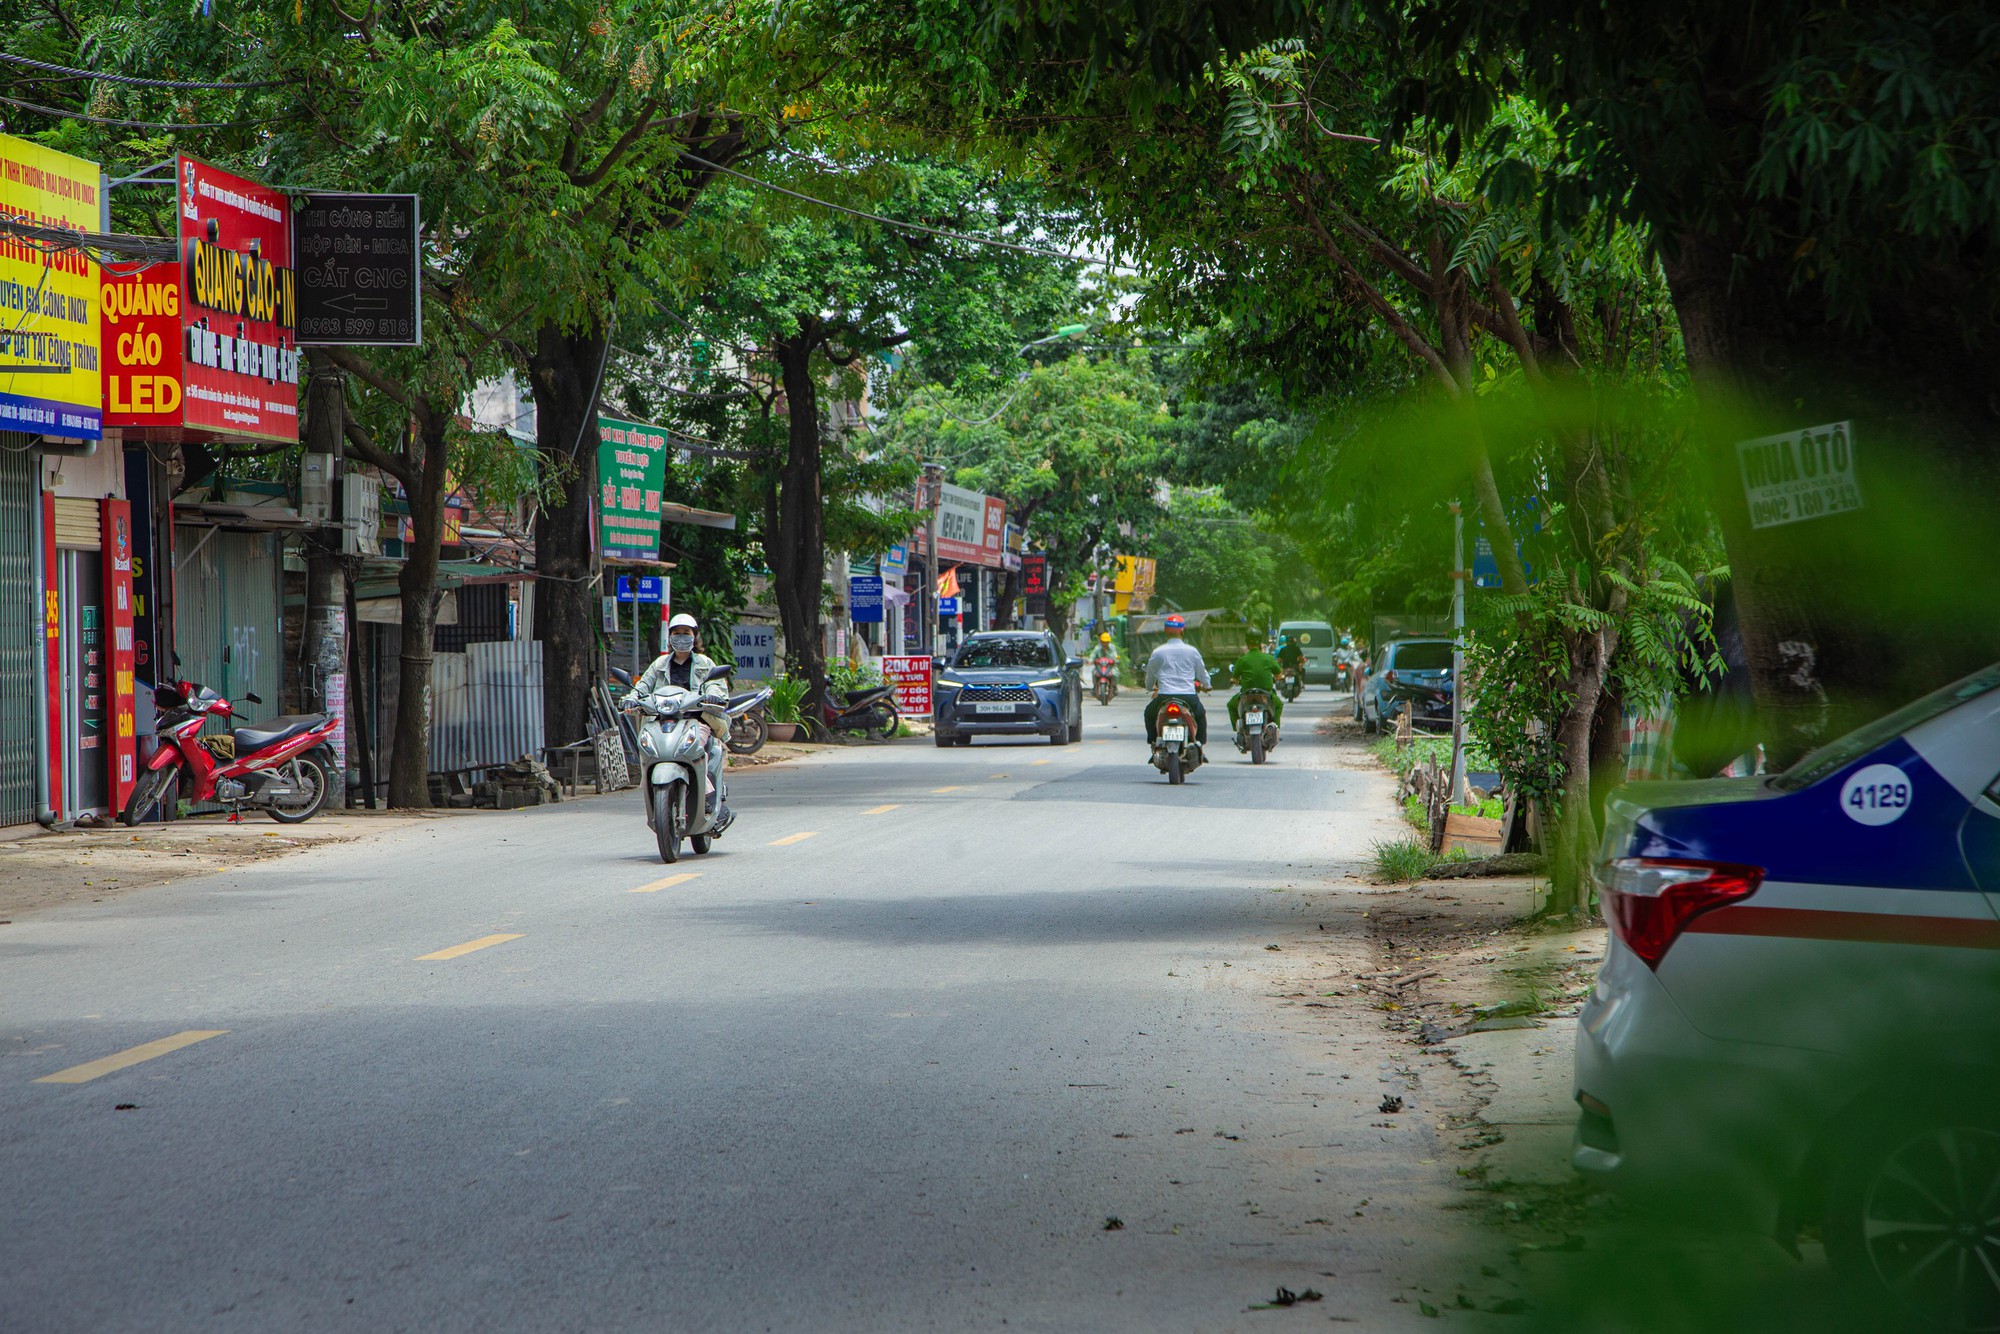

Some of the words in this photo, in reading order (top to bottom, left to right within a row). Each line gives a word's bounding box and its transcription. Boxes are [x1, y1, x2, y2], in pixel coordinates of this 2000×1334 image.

[82, 184, 95, 206] INOX
[304, 210, 325, 227] THI
[329, 206, 372, 227] CÔNG
[376, 203, 405, 228] BIỂN
[302, 233, 331, 257] HỘP
[334, 233, 361, 253] ĐÈN
[373, 238, 409, 254] MICA
[188, 217, 243, 316] QUẢNG
[303, 257, 349, 288] CẮT
[355, 267, 407, 288] CNC
[68, 296, 88, 325] INOX
[101, 272, 178, 324] QUẢNG
[302, 318, 341, 335] 0983
[345, 319, 375, 335] 599
[379, 319, 408, 335] 518
[74, 339, 98, 372] TRÌNH
[117, 322, 162, 366] CÁO
[109, 375, 181, 413] LED
[1743, 440, 1800, 489] MUA
[1753, 496, 1790, 525] 0902
[46, 590, 59, 624] 545
[117, 581, 128, 610] HÀ
[115, 627, 132, 651] VINH
[116, 663, 133, 698] QUẢNG
[885, 659, 910, 673] 20K
[118, 708, 133, 737] CÁO
[120, 754, 132, 783] LED
[1849, 783, 1907, 810] 4129
